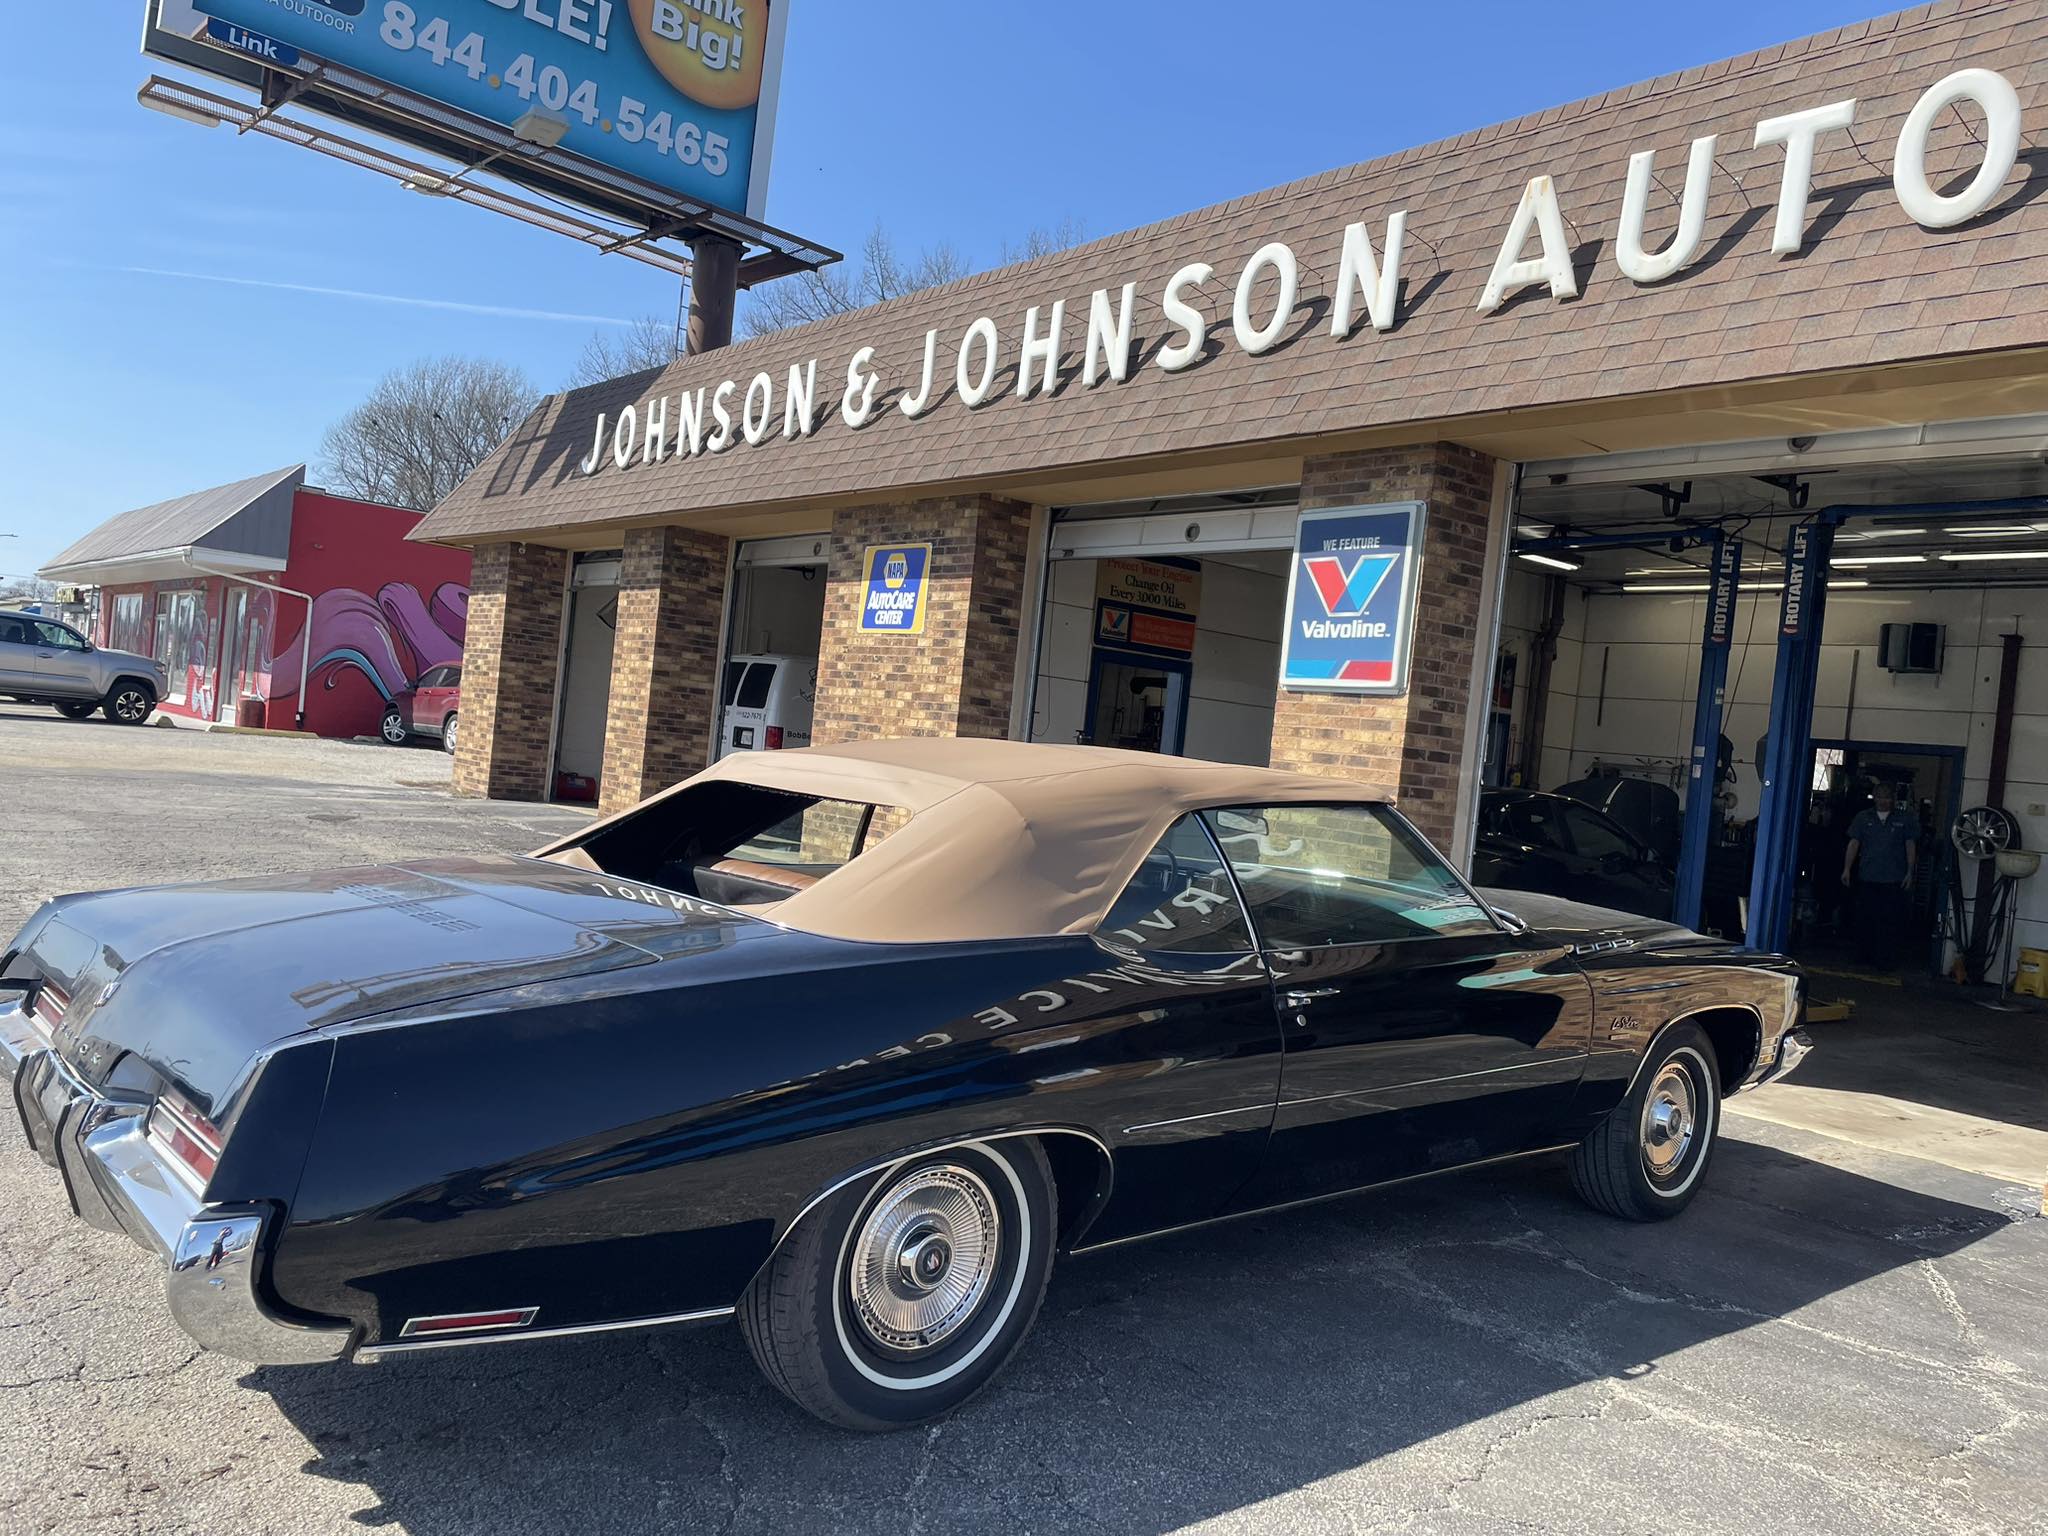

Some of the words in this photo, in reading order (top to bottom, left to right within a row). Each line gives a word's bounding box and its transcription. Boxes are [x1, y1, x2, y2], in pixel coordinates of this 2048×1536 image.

[283, 0, 355, 35] OUTDOOR
[228, 27, 277, 59] Link
[652, 0, 742, 70] Big!
[379, 0, 729, 176] 844.404.5465
[581, 358, 818, 476] JOHNSON
[841, 346, 880, 429] &
[899, 209, 1409, 418] JOHNSON
[1476, 68, 2022, 313] AUTO
[1323, 539, 1337, 551] WE
[1339, 537, 1381, 550] FEATURE
[1792, 527, 1809, 559] LIFT
[887, 562, 905, 579] NAPA
[1125, 574, 1159, 593] Change
[1161, 581, 1175, 595] Oil
[1110, 584, 1136, 602] Every
[1162, 595, 1187, 609] Miles
[1712, 577, 1731, 635] ROTARY
[1785, 563, 1805, 625] ROTARY
[874, 610, 904, 625] CENTER
[1302, 620, 1387, 639] Valvoline
